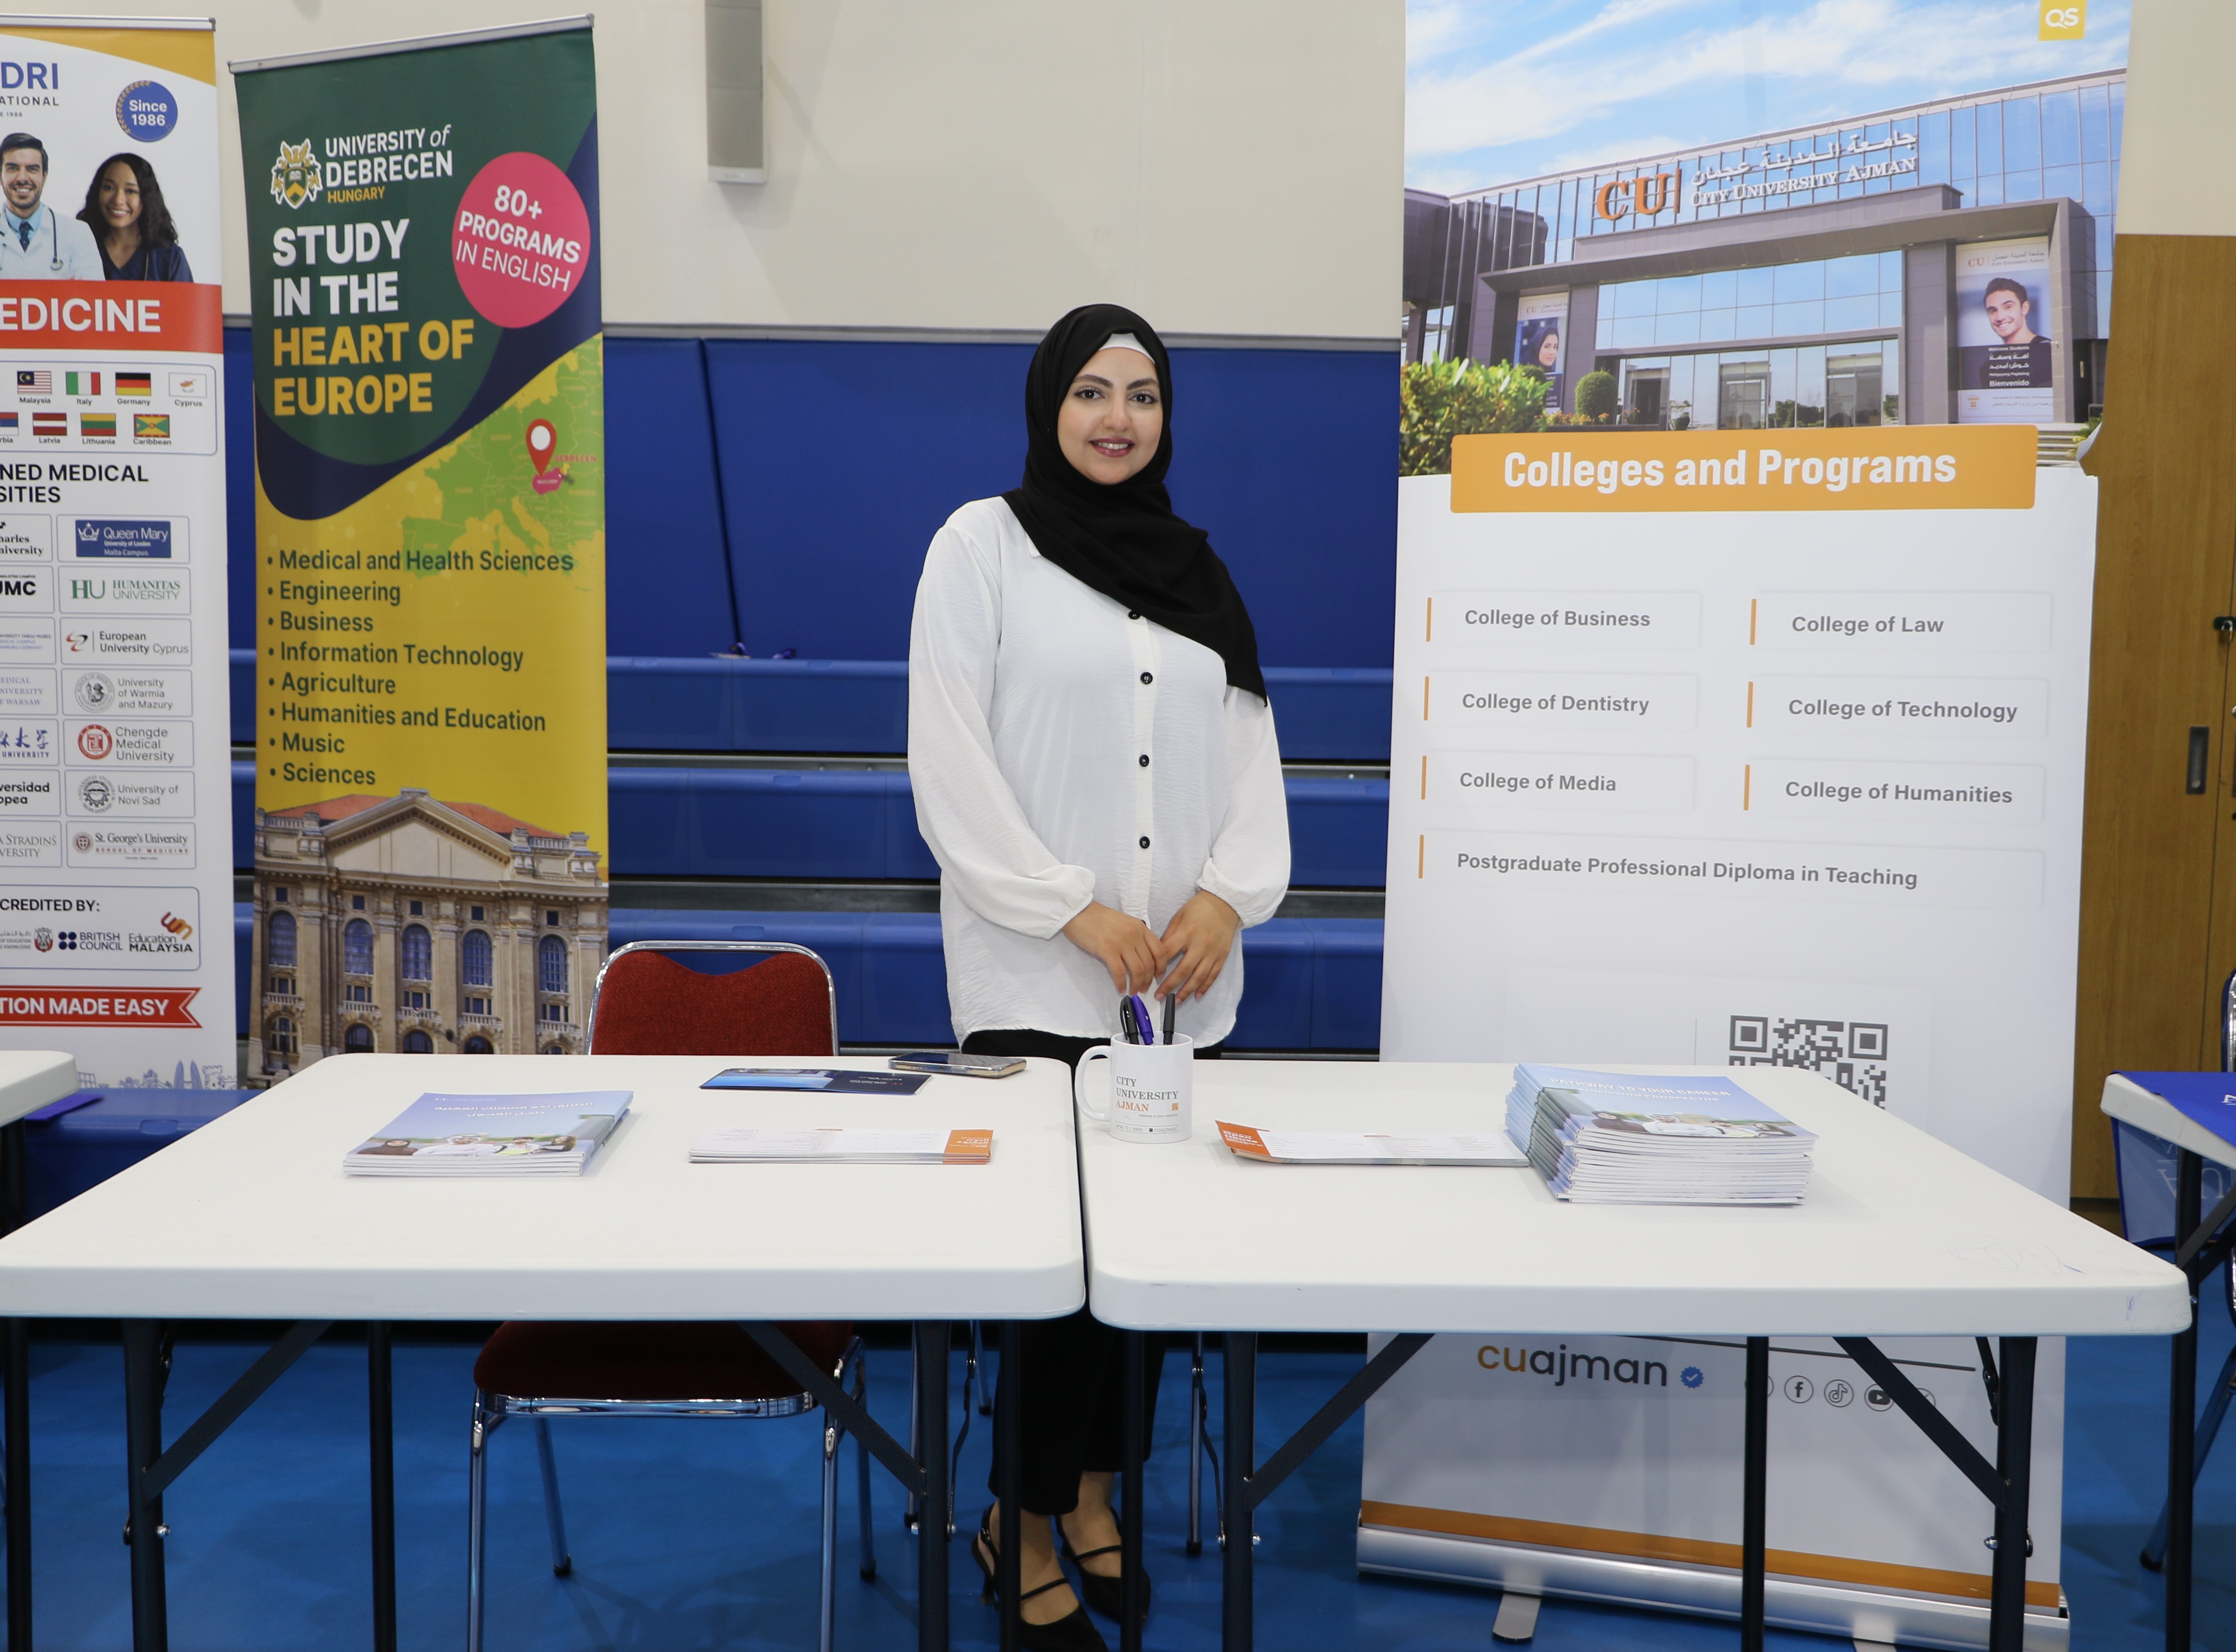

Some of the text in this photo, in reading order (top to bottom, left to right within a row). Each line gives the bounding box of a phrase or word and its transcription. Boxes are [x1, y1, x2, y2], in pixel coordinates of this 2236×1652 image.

[2045, 7, 2079, 29] QS
[1, 62, 58, 90] DRI
[0, 96, 59, 106] ATIONAL
[129, 99, 167, 113] Since
[131, 113, 166, 126] 1986
[326, 124, 452, 158] UNIVERSITY of
[326, 150, 453, 187] DEBRECEN
[1690, 158, 1918, 207] CITY UNIVERSITY AJMAN
[327, 186, 386, 203] HUNGARY
[494, 185, 543, 220] 80+
[1595, 172, 1670, 221] CU
[273, 219, 410, 266] STUDY
[459, 210, 581, 264] PROGRAMS
[456, 240, 571, 292] IN ENGLISH
[273, 272, 398, 317] IN THE
[0, 298, 161, 334] EDICINE
[274, 319, 474, 366] HEART OF
[19, 397, 51, 405] Malaysia
[76, 398, 92, 406] Italy
[174, 399, 203, 407] Cyprus
[274, 373, 432, 416] EUROPE
[0, 464, 149, 482] NED MEDICAL
[1504, 449, 1956, 494] Colleges and Programs
[103, 527, 169, 543] Queen Mary
[279, 549, 574, 571] Medical and Health Sciences
[70, 580, 105, 599] HU
[113, 580, 181, 590] HUMANITAS
[280, 580, 401, 606] Engineering
[113, 590, 180, 600] UNIVERSITY
[280, 611, 374, 632] Business
[1464, 609, 1651, 628] College of Business
[1791, 616, 1945, 636] College of Law
[100, 631, 147, 642] European
[100, 643, 189, 655] University Cyprus
[281, 641, 524, 672] Information Technology
[118, 678, 165, 688] University
[282, 672, 396, 696] Agriculture
[138, 701, 173, 711] Mazury
[1462, 693, 1650, 716] College of Dentistry
[1788, 699, 2018, 723] College of Technology
[282, 702, 546, 731] Humanities and Education
[116, 727, 168, 739] Chengde
[282, 731, 345, 753] Music
[116, 739, 161, 749] Medical
[117, 751, 174, 763] University
[283, 762, 376, 785] Sciences
[1459, 772, 1617, 792] College of Media
[118, 785, 179, 795] University of
[1785, 781, 2013, 803] College of Humanities
[95, 833, 187, 845] St. George's University
[1457, 853, 1918, 890] Postgraduate Professional Diploma in Teaching
[0, 899, 100, 912] CREDITED BY:
[79, 932, 120, 941] BRITISH
[79, 941, 123, 950] COUNCIL
[129, 933, 176, 943] Education
[129, 943, 193, 952] MALAYSIA
[49, 998, 110, 1015] MADE
[114, 998, 170, 1016] EASY
[1116, 1075, 1137, 1087] CITY
[1550, 1078, 1615, 1090] PATHWAY
[1116, 1087, 1179, 1100] UNIVERSITY
[1115, 1100, 1149, 1112] AJMAN
[1477, 1344, 1668, 1387] cuajman
